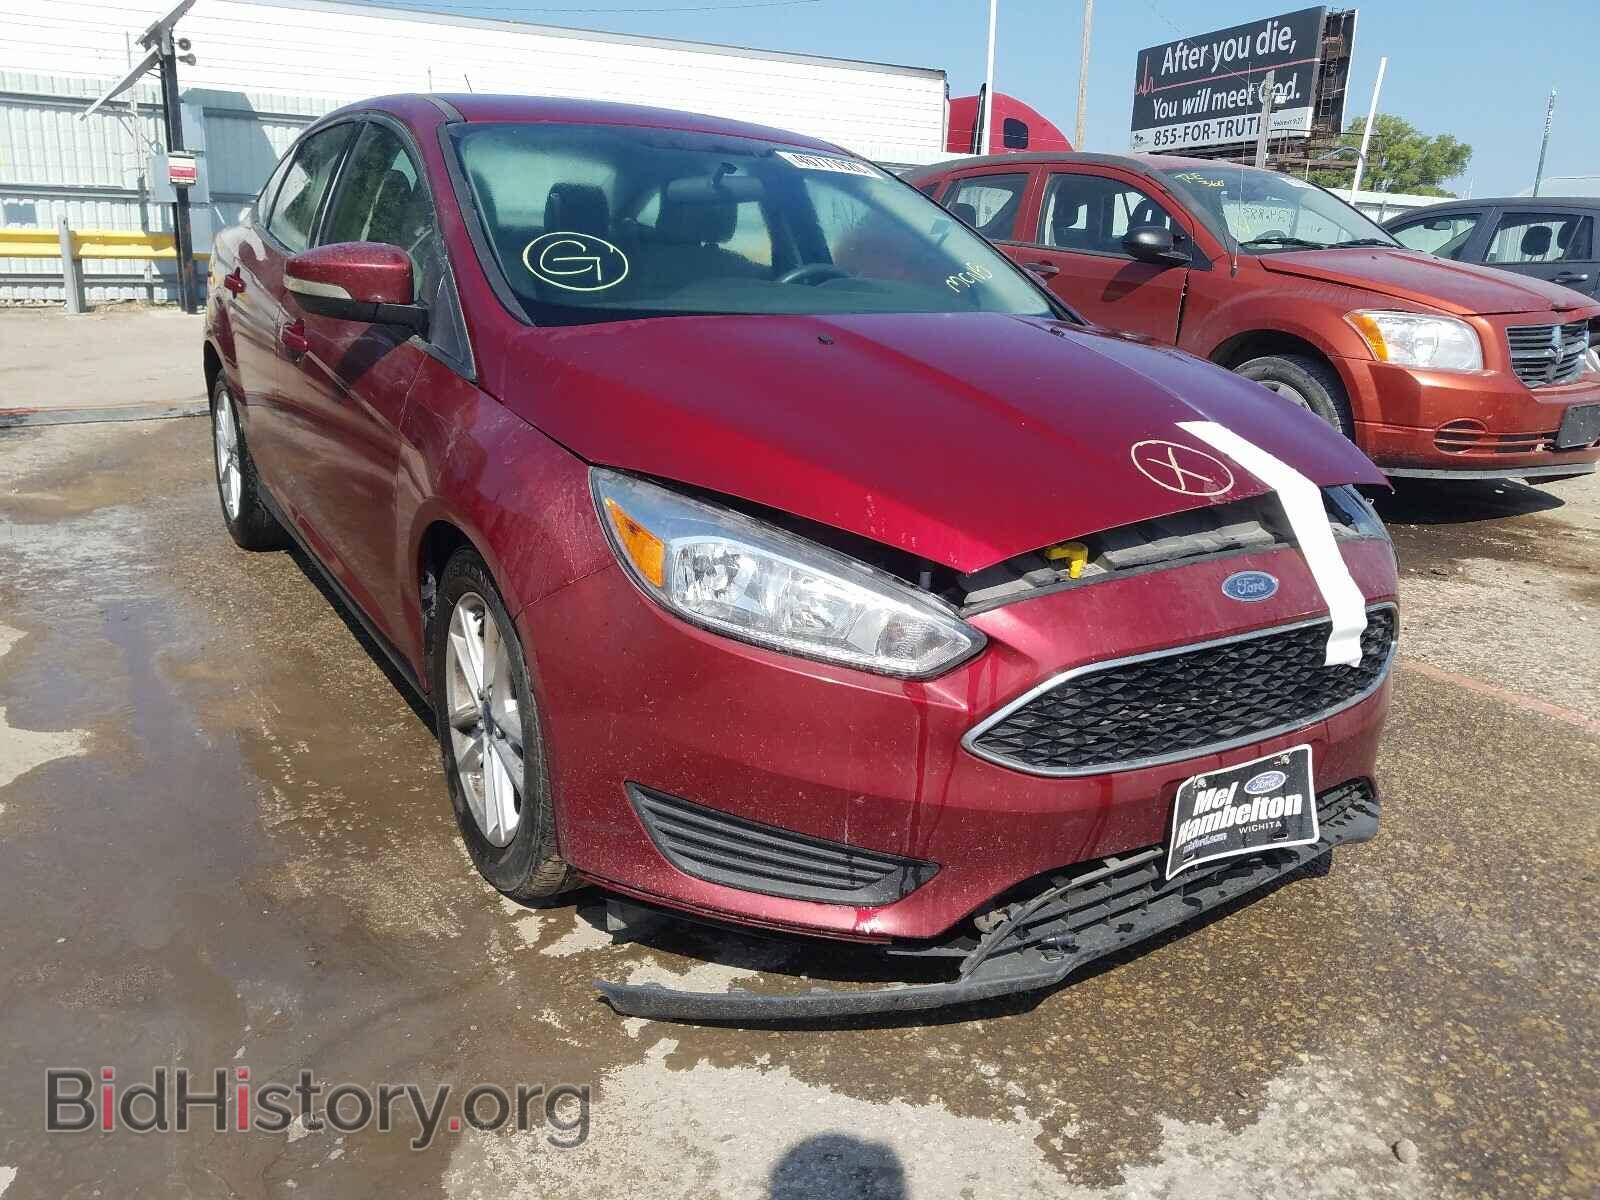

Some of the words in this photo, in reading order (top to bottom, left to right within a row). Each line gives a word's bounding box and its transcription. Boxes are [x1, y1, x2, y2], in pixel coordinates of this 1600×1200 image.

[1161, 42, 1208, 75] After
[1209, 37, 1250, 73] you
[1255, 20, 1296, 55] die,
[1153, 97, 1178, 120] You
[1182, 87, 1211, 116] will
[1211, 83, 1253, 110] meet
[1236, 580, 1267, 594] Ford
[1192, 781, 1239, 816] Mel
[1239, 821, 1282, 834] WICHITA
